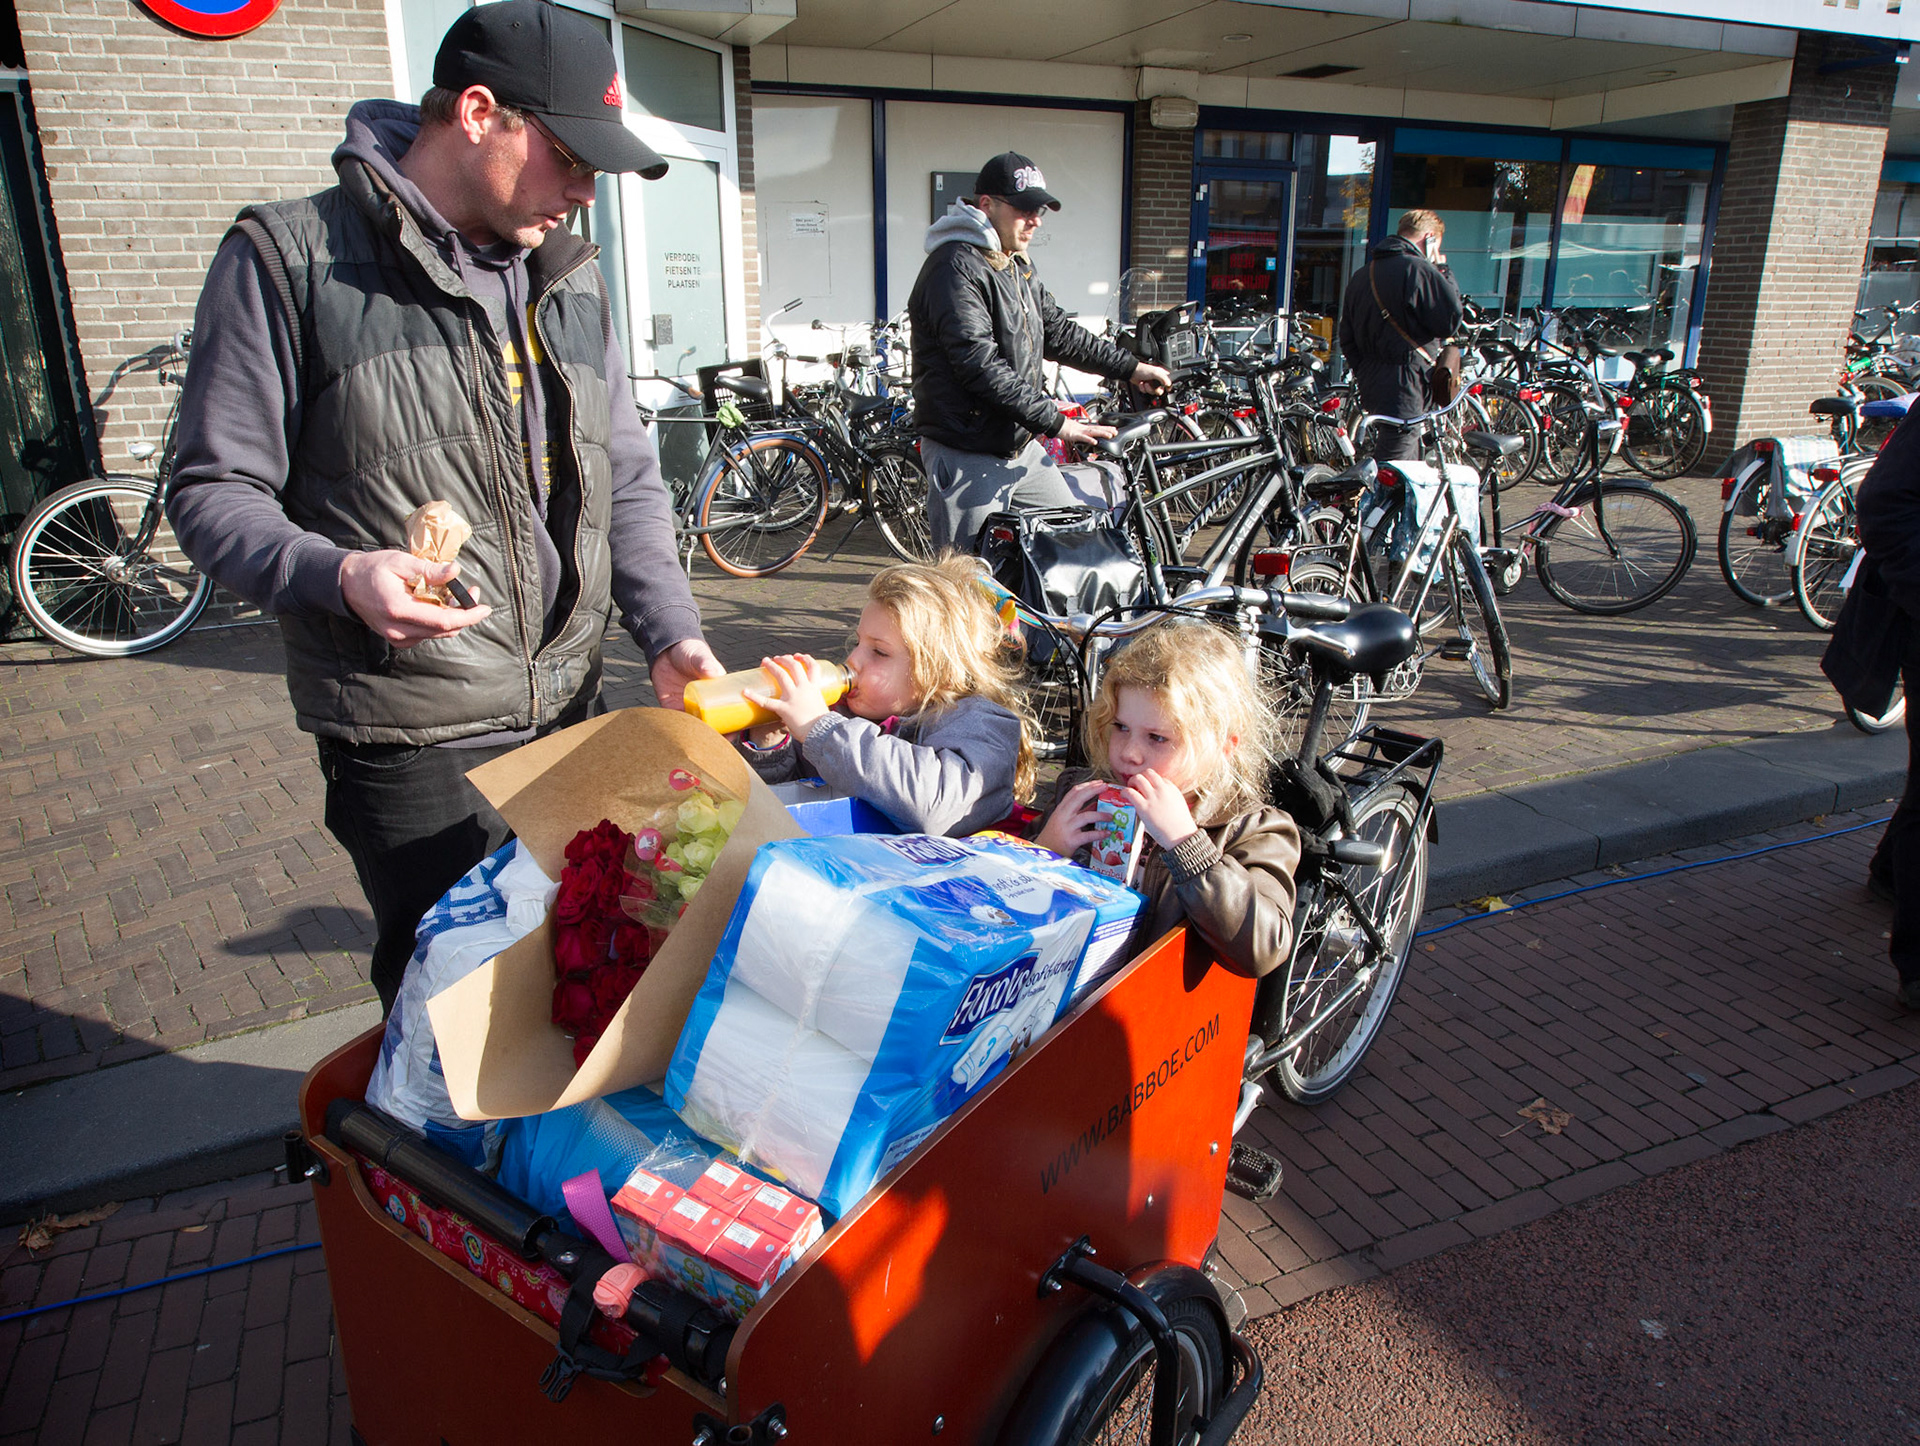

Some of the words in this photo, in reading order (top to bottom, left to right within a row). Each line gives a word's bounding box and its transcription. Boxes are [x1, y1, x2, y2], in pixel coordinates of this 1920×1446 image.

[664, 252, 701, 262] VERBODEN
[665, 266, 692, 275] FIETSEN
[693, 266, 701, 276] TE
[667, 279, 700, 289] PLAATSEN
[1228, 496, 1268, 556] GAZELLE
[1040, 1013, 1220, 1195] WWW.BABBOE.COM
